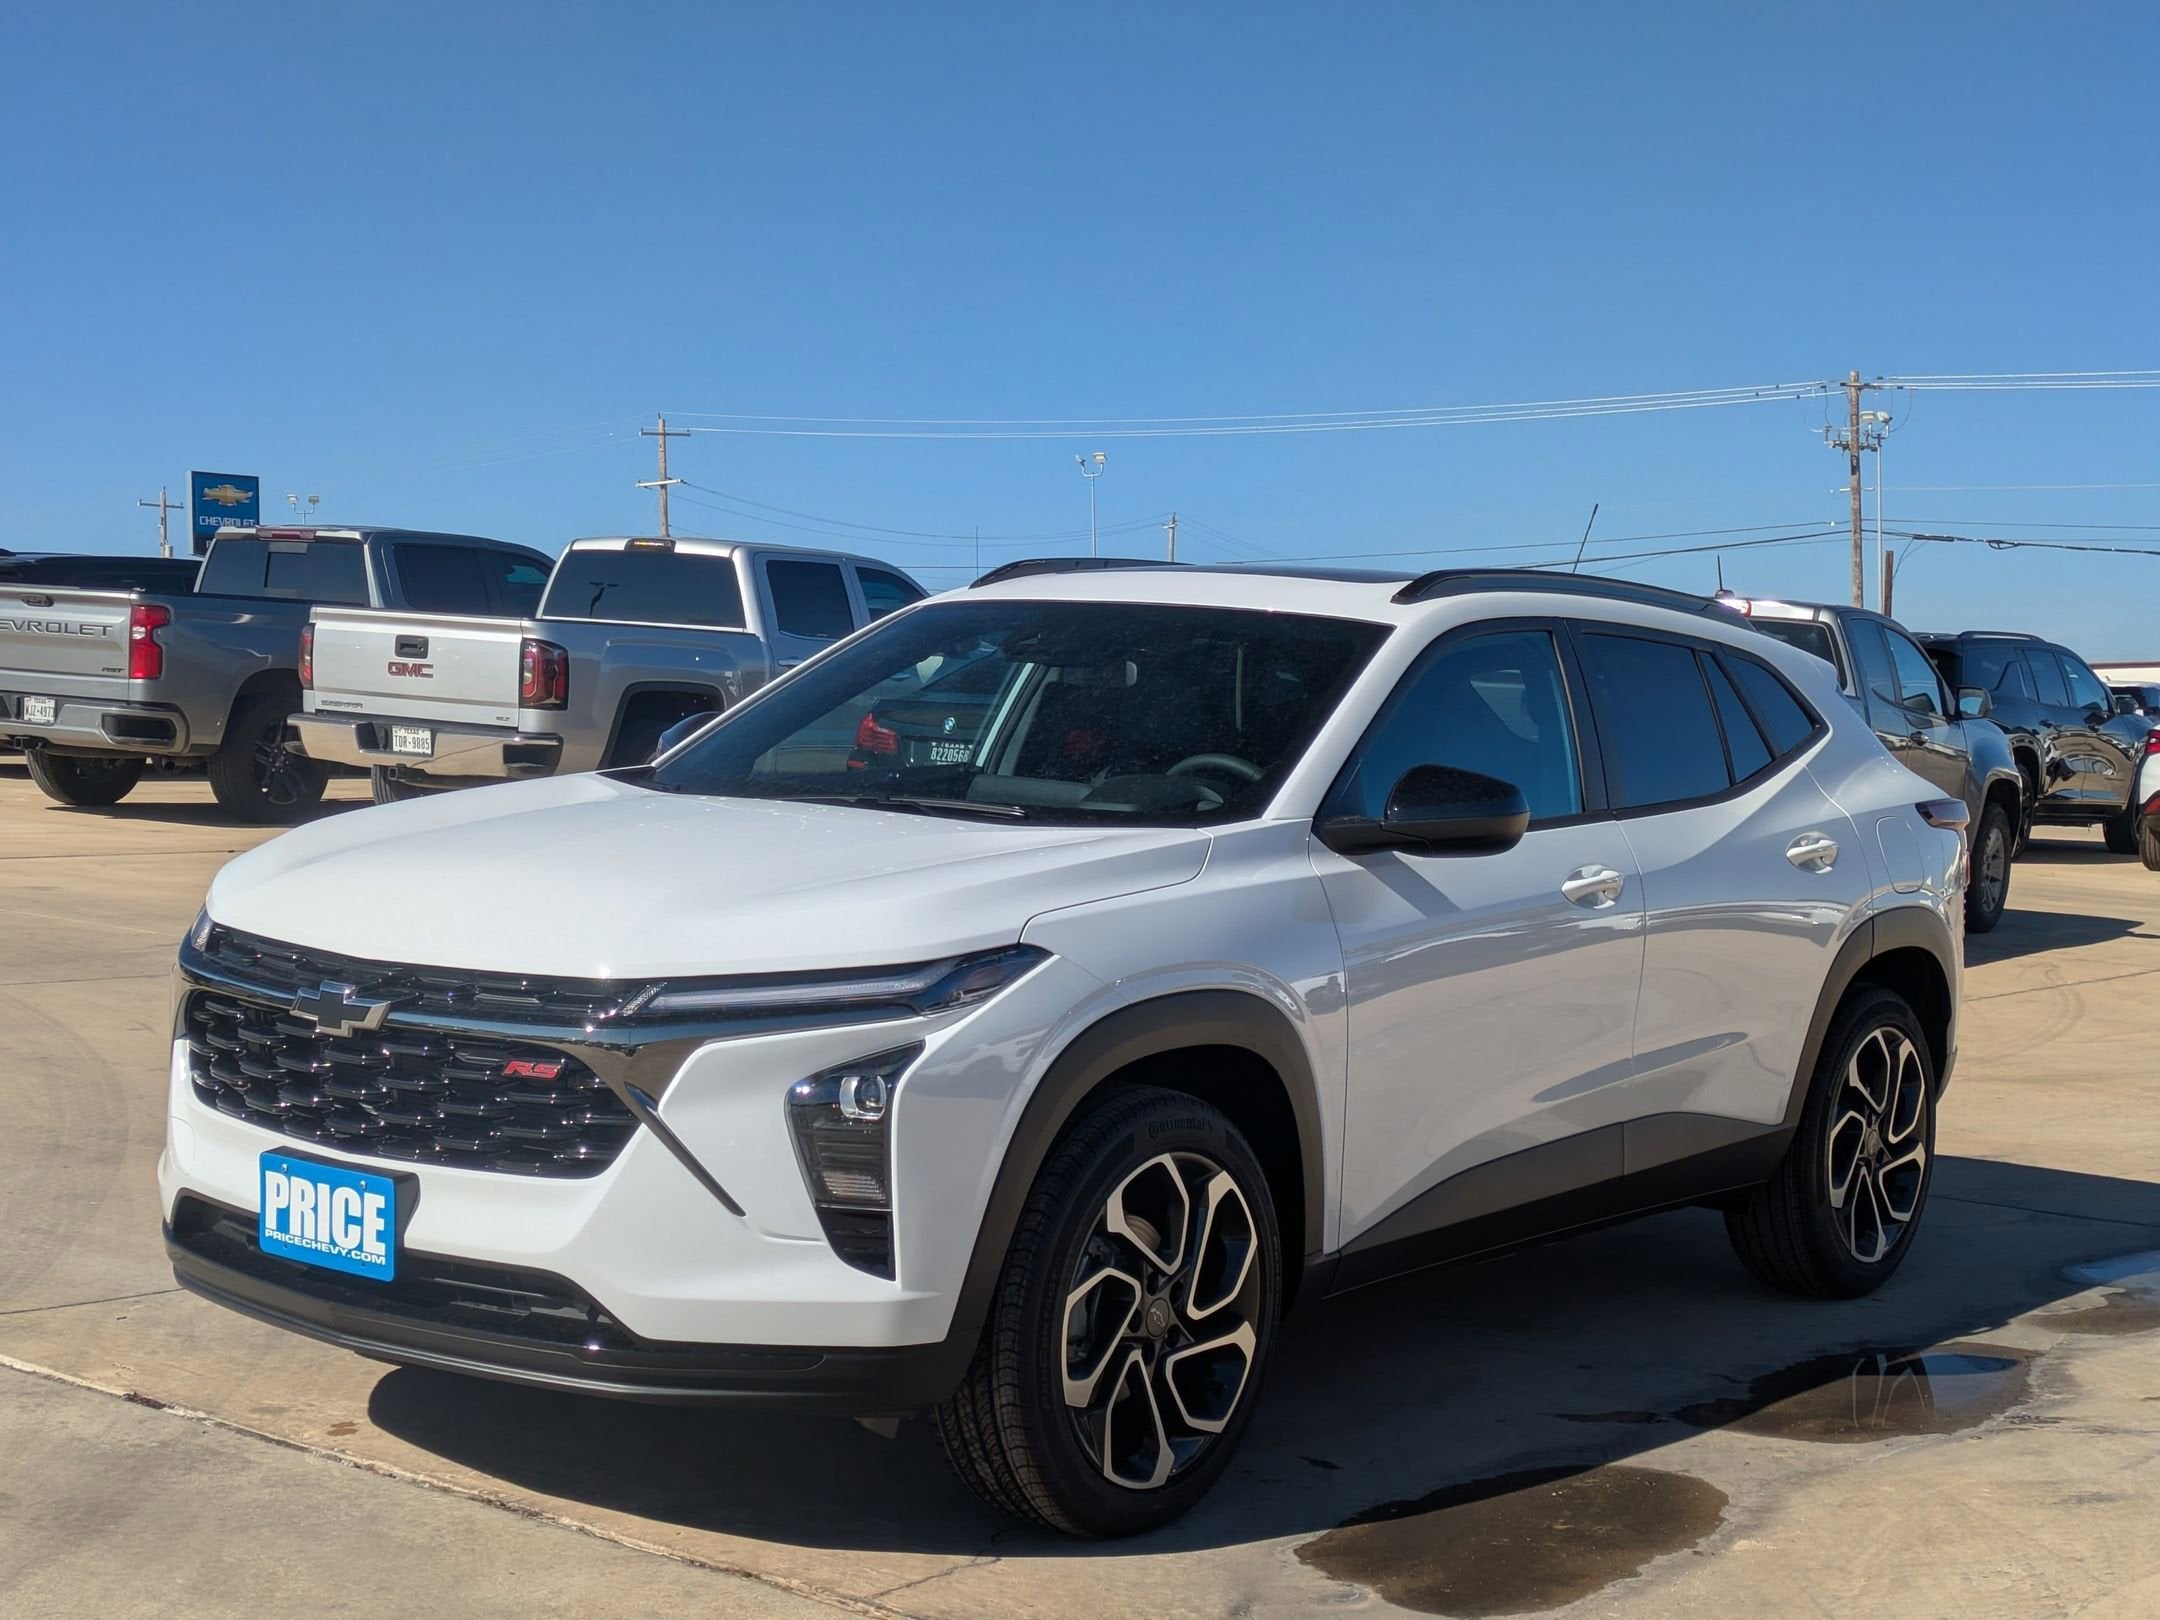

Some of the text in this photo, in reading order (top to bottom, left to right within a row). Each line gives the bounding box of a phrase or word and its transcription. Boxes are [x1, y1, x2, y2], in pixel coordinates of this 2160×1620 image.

[387, 661, 434, 678] GMC
[502, 1060, 561, 1079] RS
[1148, 1116, 1205, 1140] Continental
[265, 1170, 386, 1256] PRICE
[264, 1228, 386, 1266] PRICECHEVY.COM
